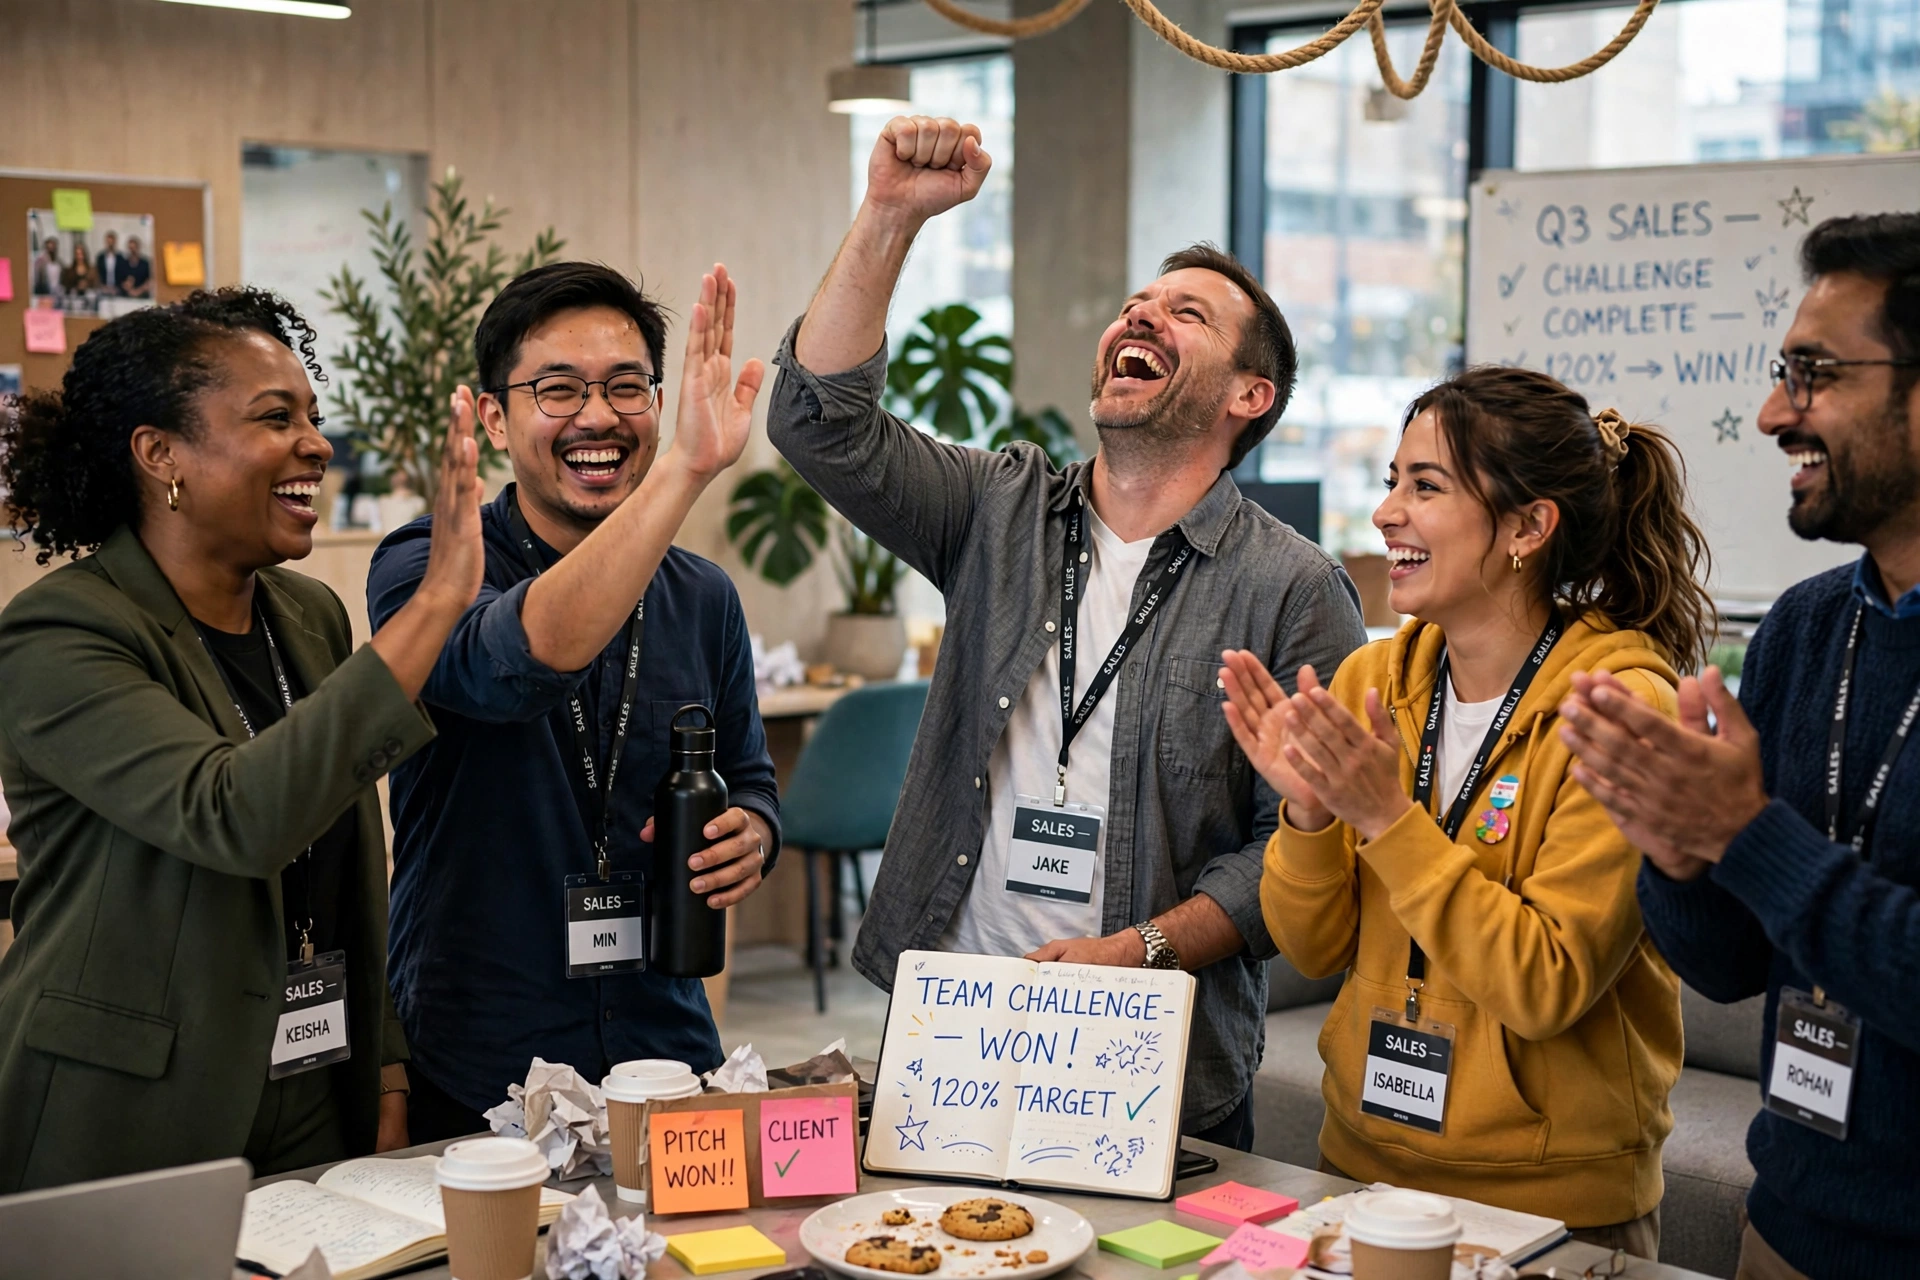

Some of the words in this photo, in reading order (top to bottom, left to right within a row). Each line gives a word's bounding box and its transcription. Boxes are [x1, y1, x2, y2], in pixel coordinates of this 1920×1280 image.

[1536, 204, 1591, 248] Q3
[1607, 201, 1712, 241] SALES
[1542, 258, 1713, 297] CHALLENGE
[1542, 302, 1697, 339] COMPLETE
[1545, 350, 1617, 385] 120%
[1674, 343, 1767, 385] WIN!!
[1064, 625, 1073, 660] SALES
[571, 697, 585, 733] SALES
[617, 702, 630, 737] SALES
[583, 755, 597, 789] SALES
[1418, 754, 1432, 788] SALES
[1031, 818, 1075, 838] SALES
[1032, 856, 1070, 875] JAKE
[583, 895, 622, 911] SALES
[593, 932, 617, 948] MIN
[285, 979, 324, 1002] SALES
[917, 977, 993, 1009] TEAM
[285, 1018, 331, 1044] KEISHA
[1385, 1034, 1427, 1058] SALES
[1793, 1019, 1835, 1049] SALES
[980, 1027, 1079, 1069] WON!
[1373, 1071, 1435, 1103] ISABELLA
[1786, 1063, 1834, 1098] ROHAN
[931, 1077, 1000, 1110] 120%
[1014, 1085, 1117, 1118] TARGET
[663, 1128, 726, 1155] PITCH
[768, 1117, 839, 1143] CLIENT
[664, 1158, 735, 1188] WON!!
